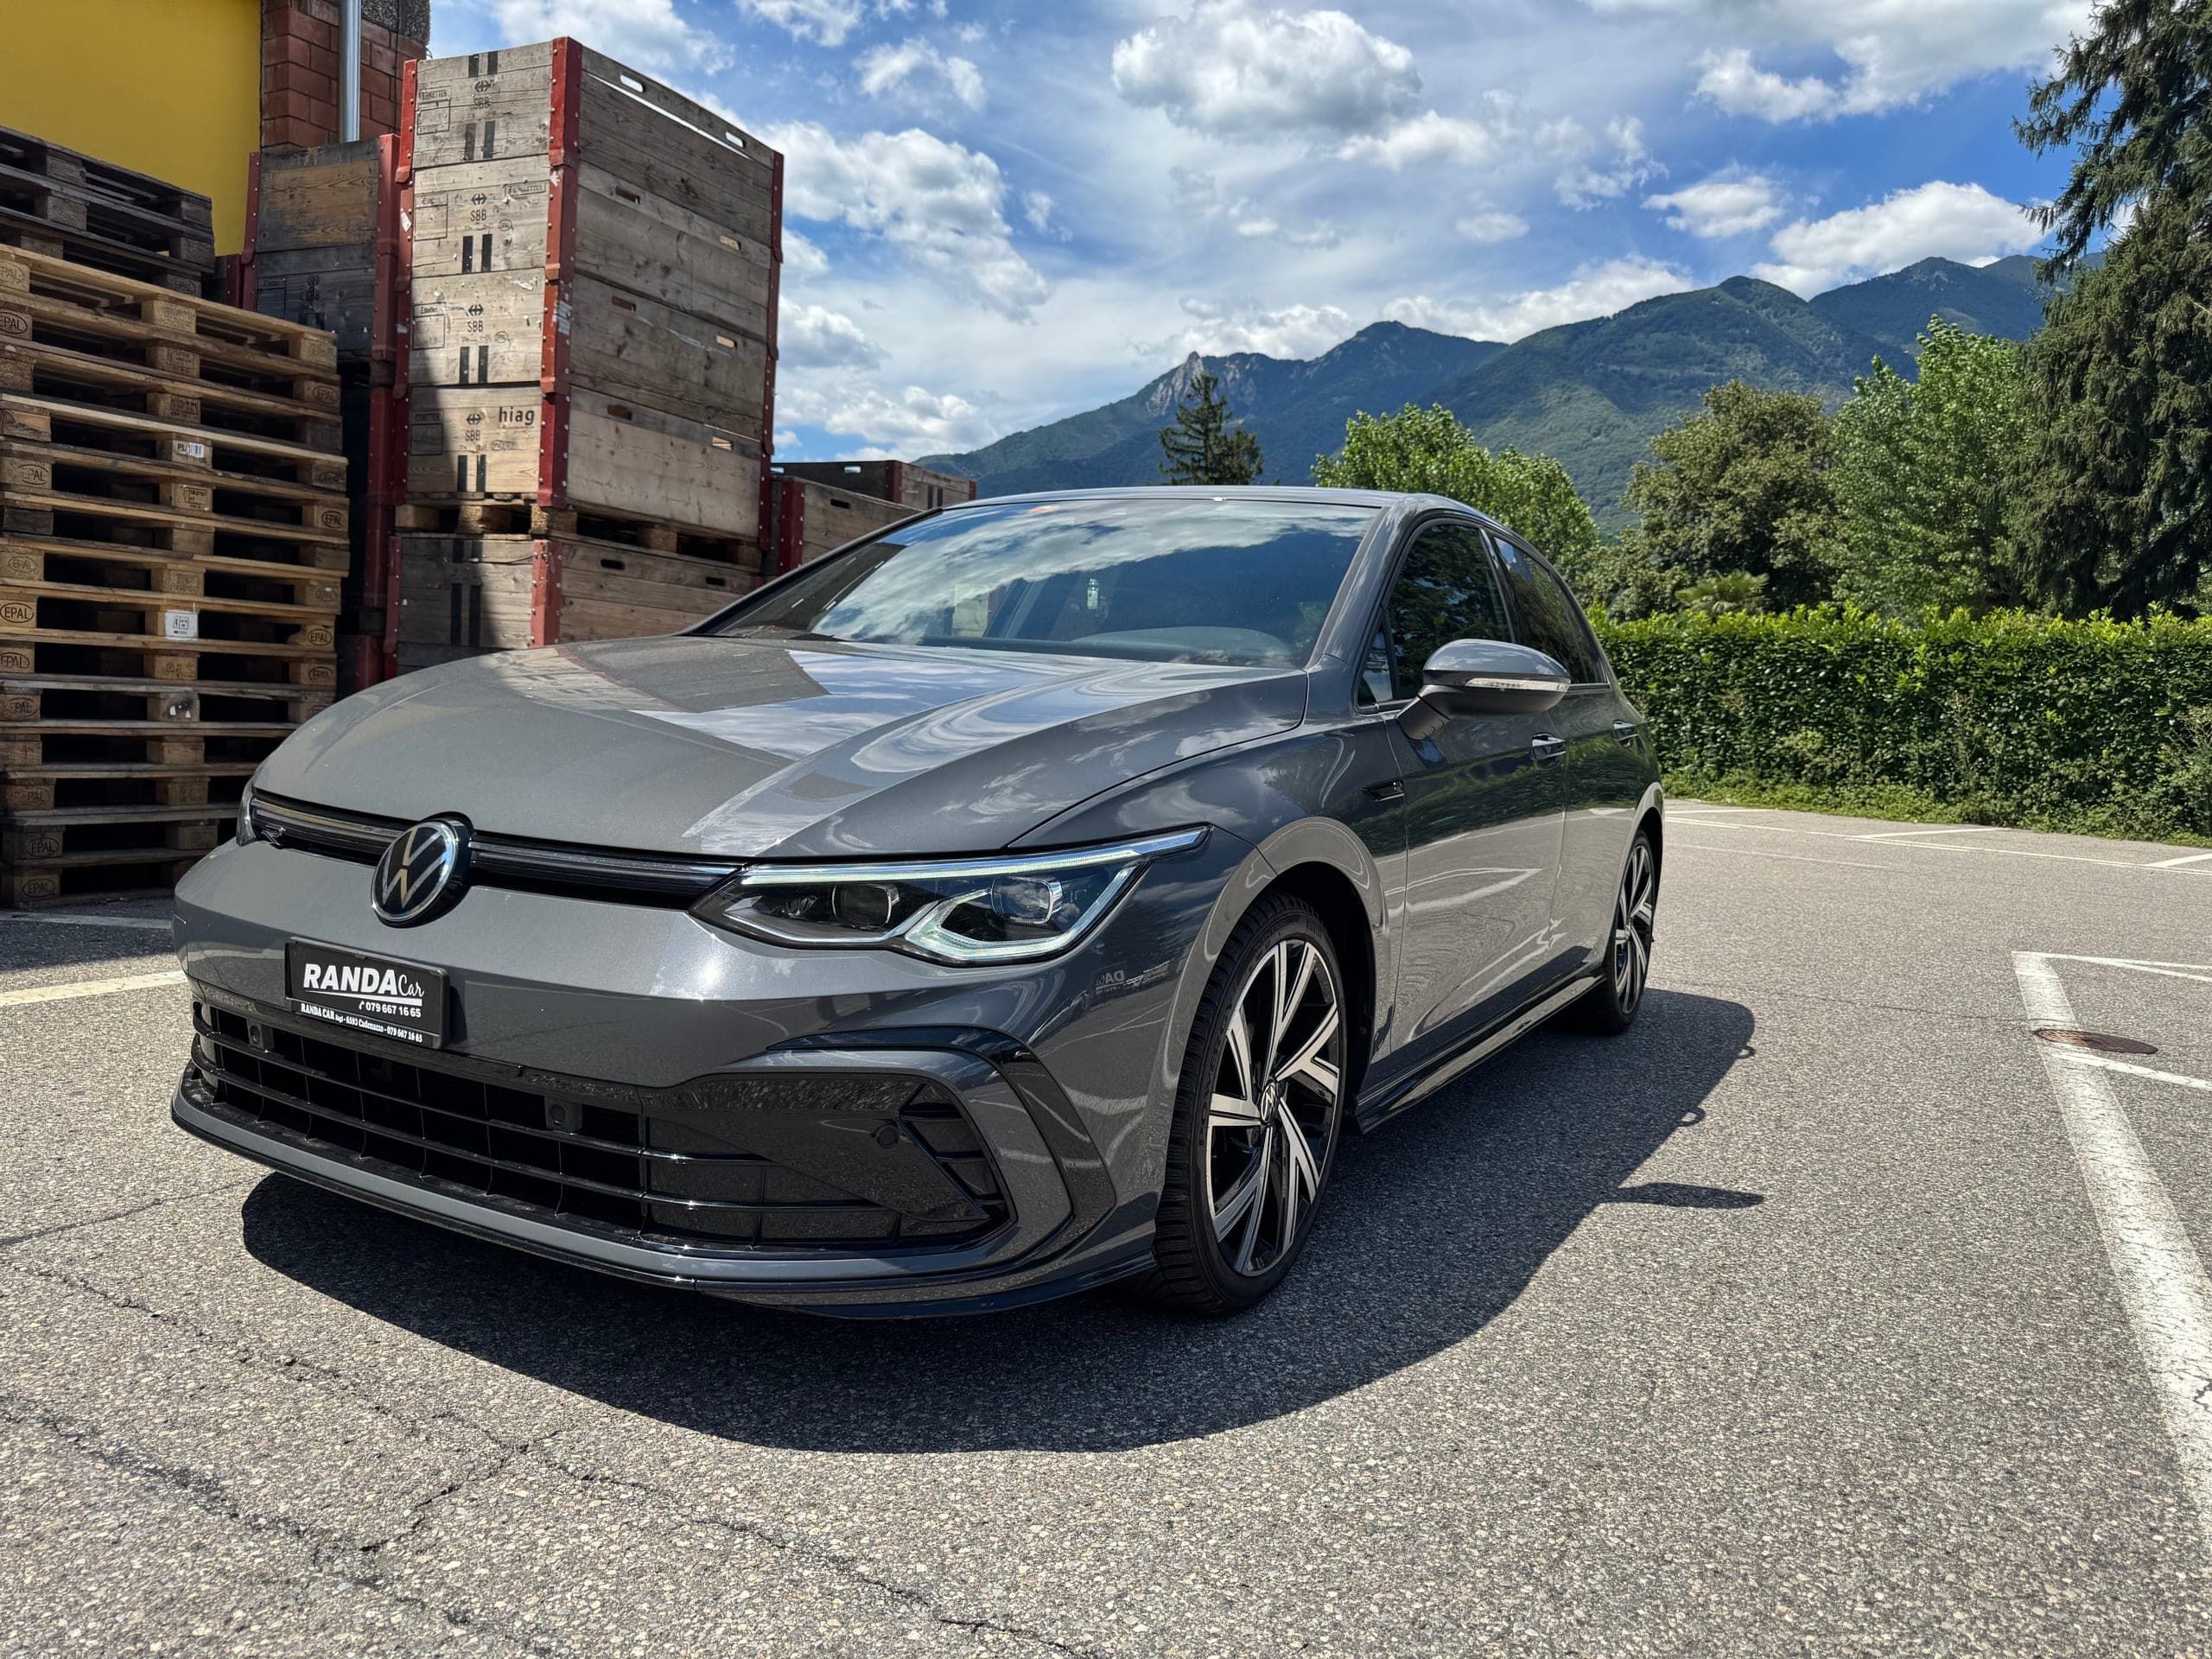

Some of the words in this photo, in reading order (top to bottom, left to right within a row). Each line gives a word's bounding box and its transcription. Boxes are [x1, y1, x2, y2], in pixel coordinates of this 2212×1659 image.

[470, 209, 486, 222] SBB
[0, 267, 20, 278] PAL
[467, 321, 484, 333] SBB
[499, 406, 535, 426] hiag
[465, 429, 480, 442] SBB
[4, 607, 29, 620] EPAL
[310, 632, 328, 643] EPAL
[31, 841, 54, 852] EPAL
[28, 883, 49, 893] EPAL
[303, 963, 397, 995] RANDA
[398, 975, 424, 997] Car
[365, 1001, 381, 1013] 079
[382, 1004, 397, 1014] 667
[398, 1006, 409, 1016] 16
[410, 1007, 422, 1018] 65
[301, 1002, 321, 1017] RANDA
[322, 1008, 334, 1020] CAR
[387, 1026, 397, 1036] 079
[408, 1031, 415, 1041] 16
[415, 1033, 423, 1043] 65
